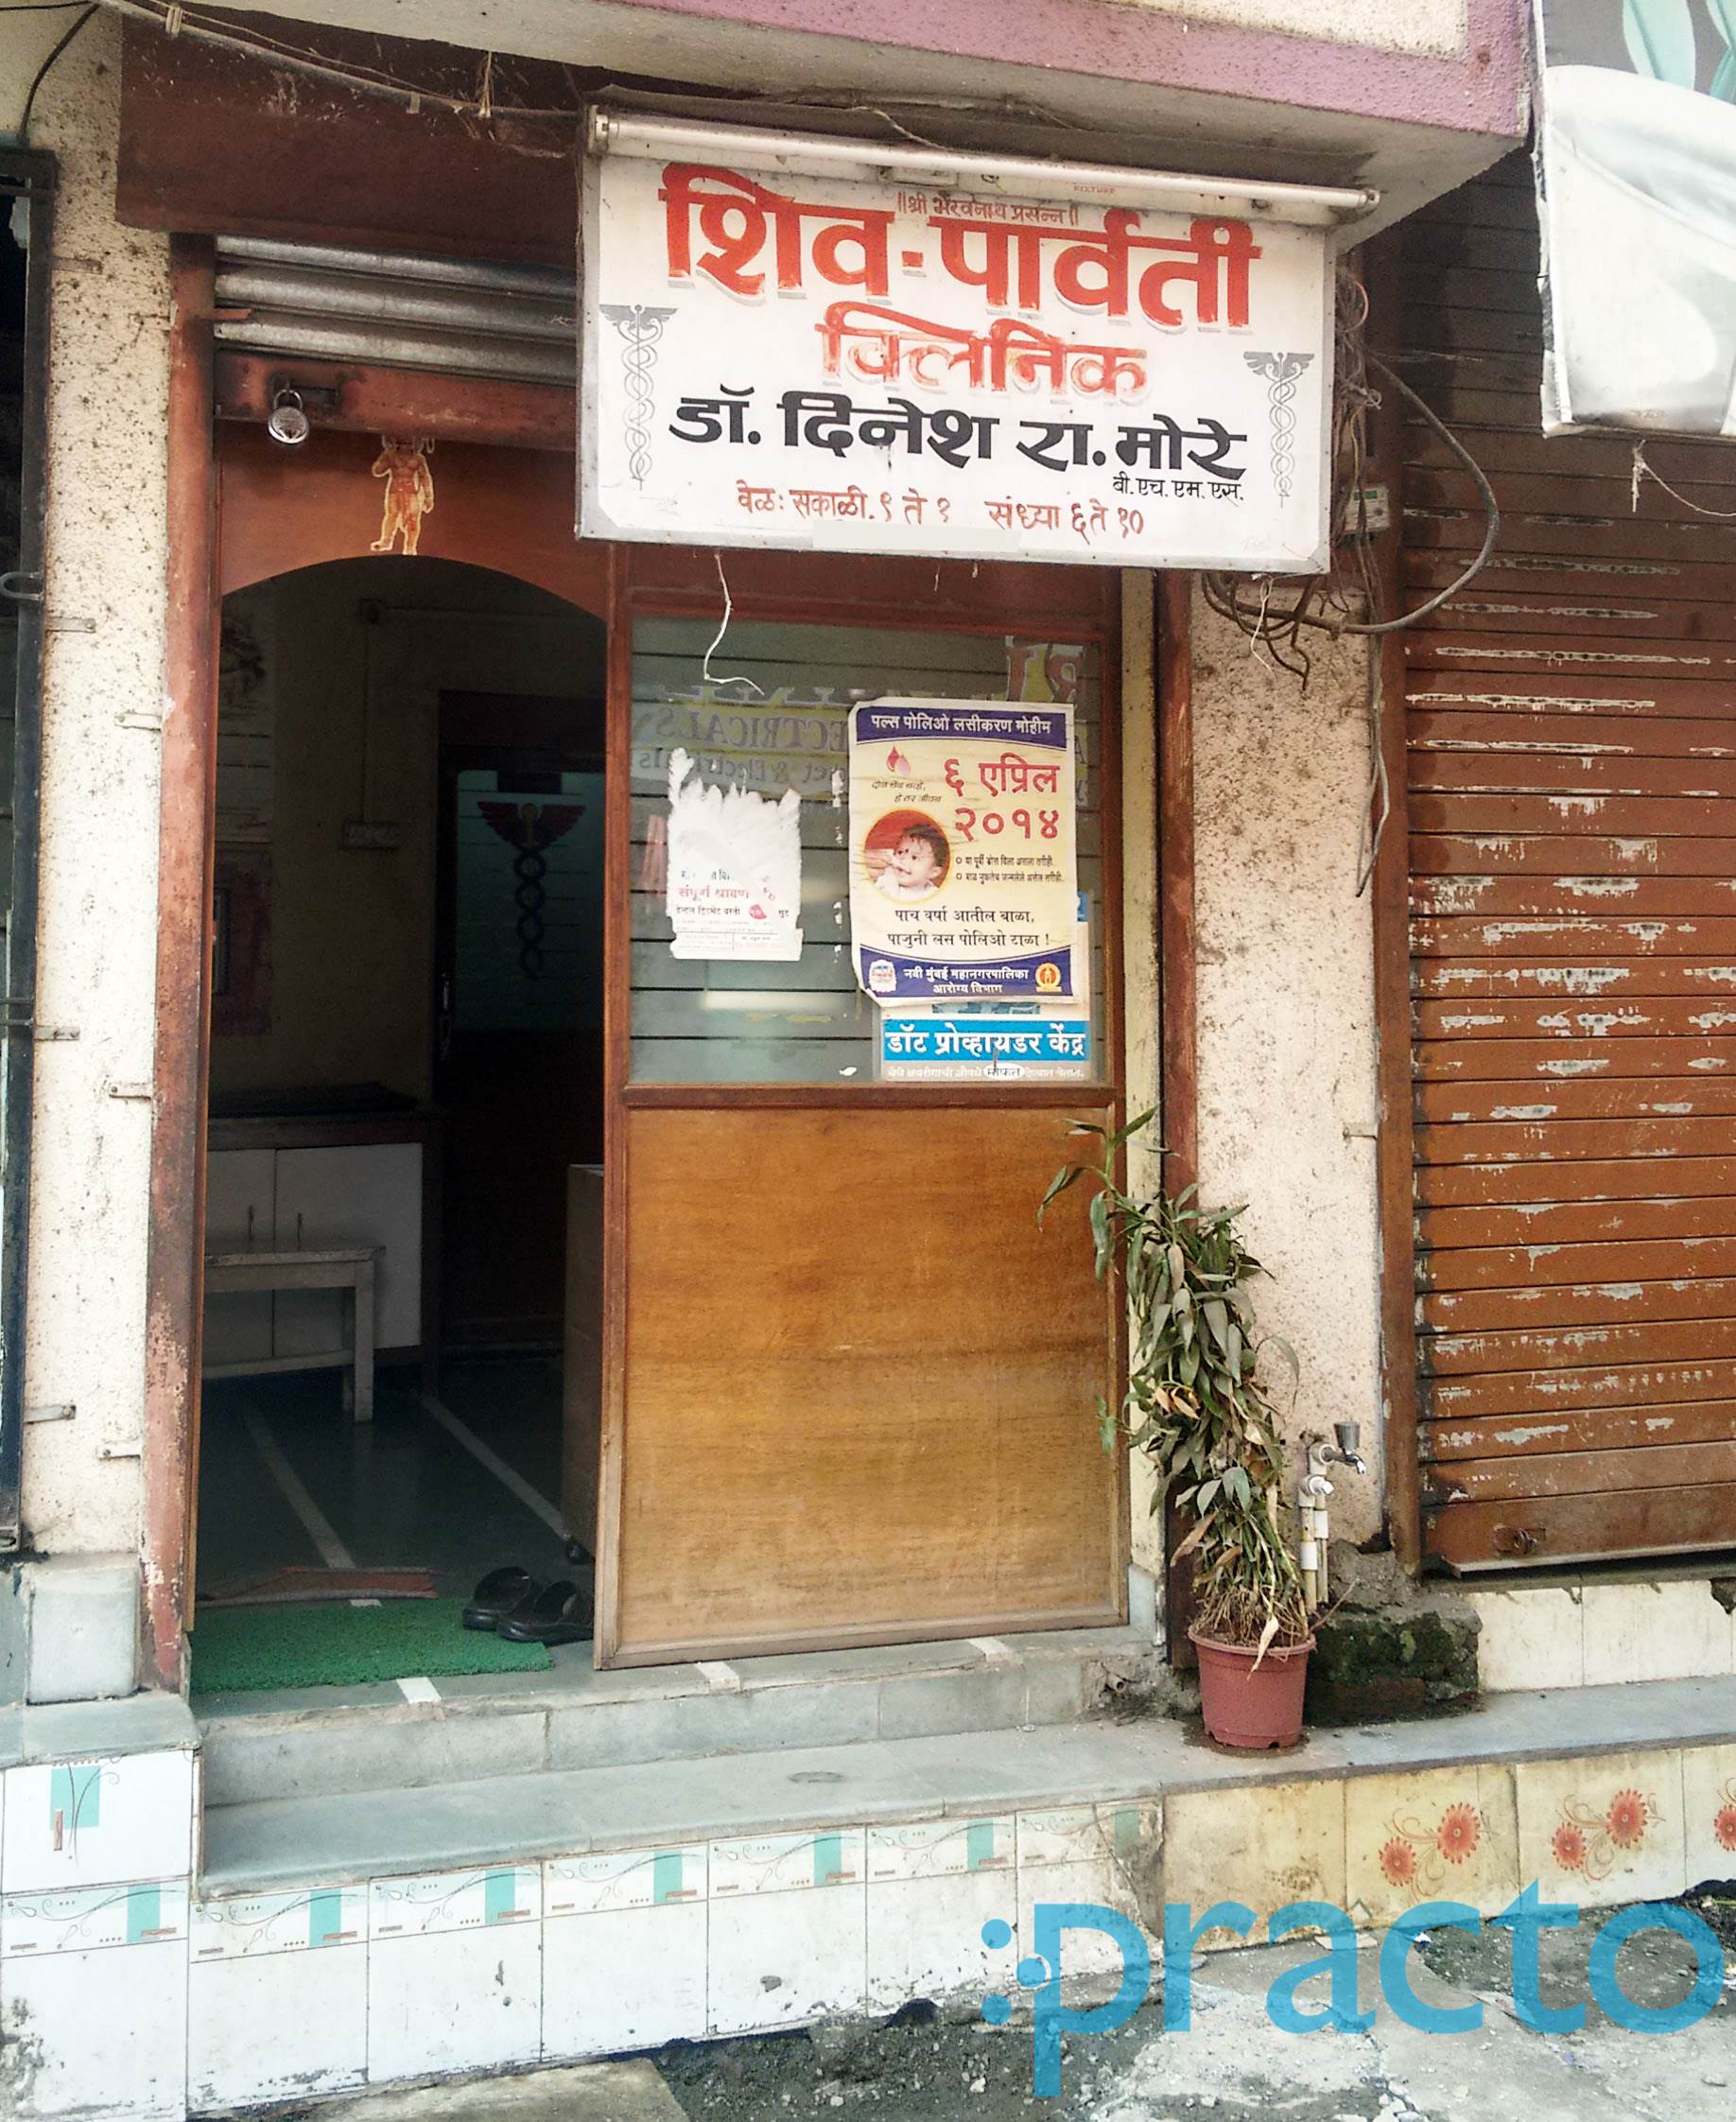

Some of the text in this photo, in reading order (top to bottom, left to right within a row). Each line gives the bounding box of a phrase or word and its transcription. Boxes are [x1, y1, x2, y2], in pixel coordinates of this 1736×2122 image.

[668, 384, 762, 445] डॉ.
[777, 390, 1000, 468] दिनेश
[902, 487, 928, 525] ते
[904, 712, 949, 731] पोलिओ
[953, 713, 1013, 734] लसीकरण
[945, 757, 964, 797] ६
[978, 752, 1060, 797] एप्रिल
[955, 807, 1059, 842] २०१४
[895, 909, 920, 923] पाच
[954, 906, 996, 923] आतील
[959, 930, 1006, 947] पोलिओ
[951, 965, 1030, 981] महानगरपालिका
[885, 1022, 1086, 1058] डॉट प्रोव्हायडर केंद्र
